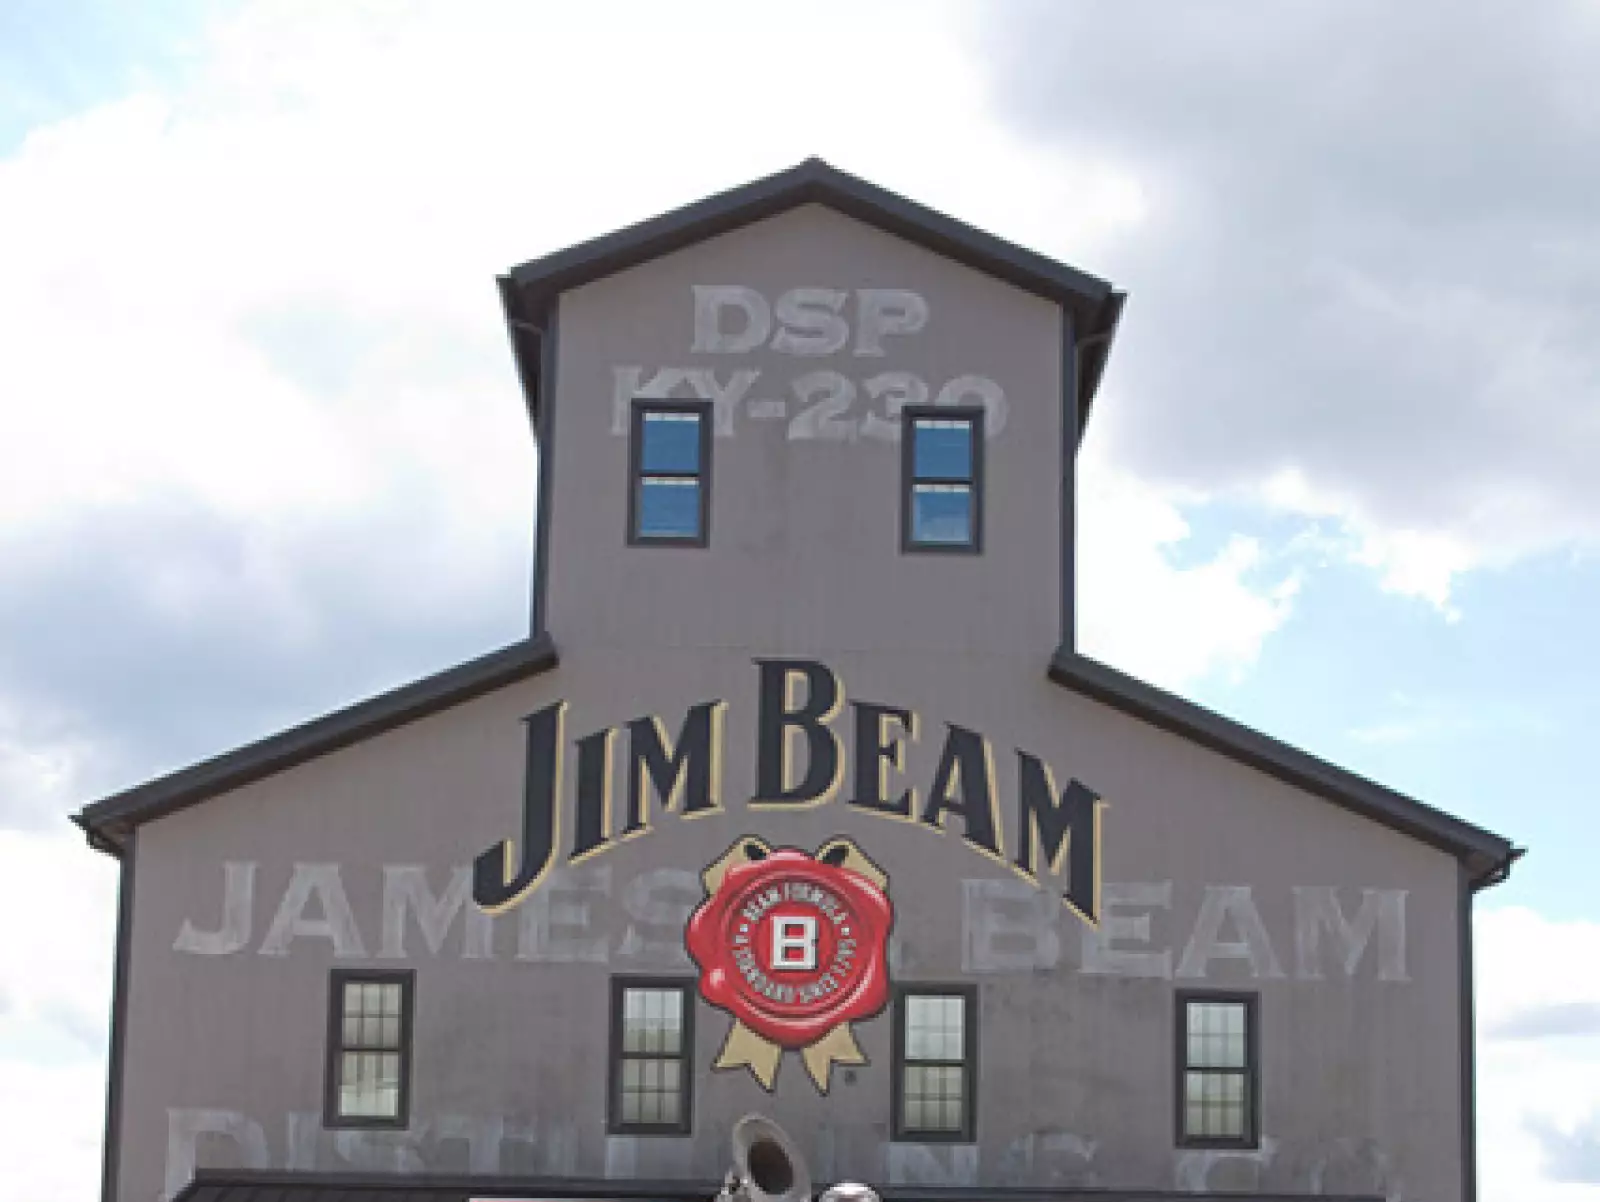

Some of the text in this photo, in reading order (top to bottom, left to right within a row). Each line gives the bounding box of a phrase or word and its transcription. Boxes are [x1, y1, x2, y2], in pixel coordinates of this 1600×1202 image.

[690, 283, 931, 358] DSP
[608, 363, 1009, 442] KY-230
[472, 656, 1111, 929] JIM BEAM
[171, 859, 1412, 982] JAMES BEAM
[770, 915, 819, 971] B
